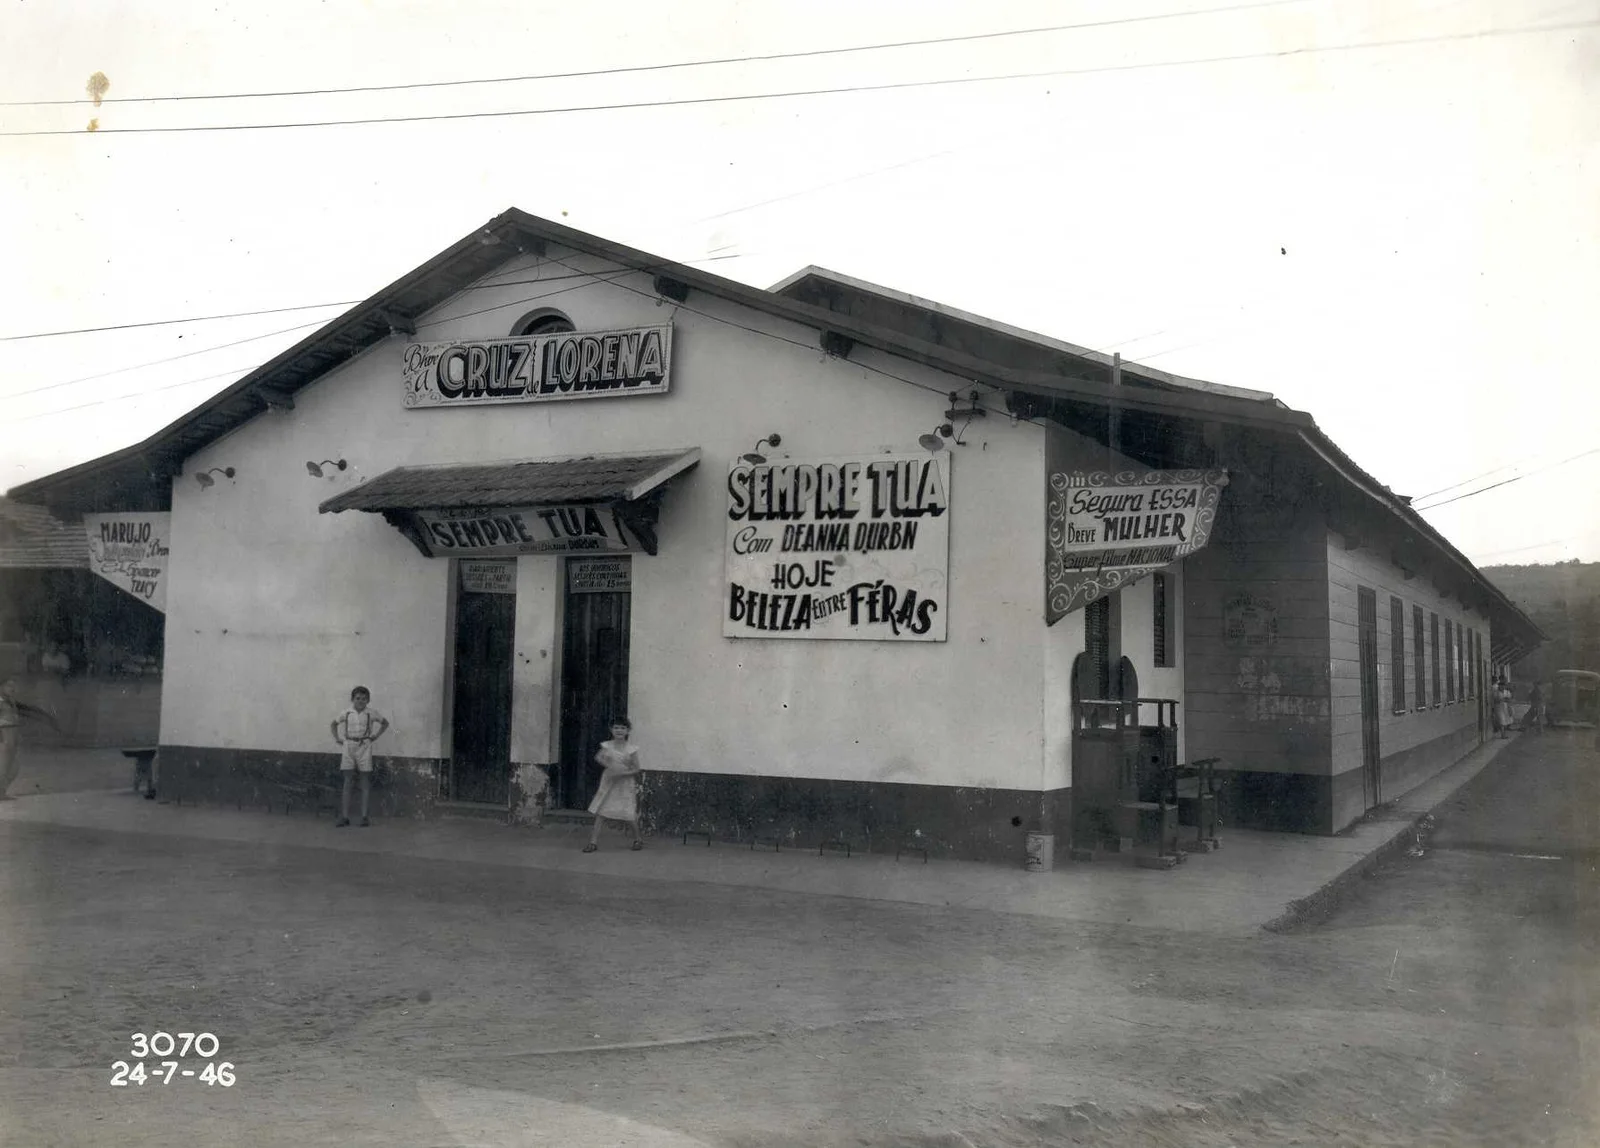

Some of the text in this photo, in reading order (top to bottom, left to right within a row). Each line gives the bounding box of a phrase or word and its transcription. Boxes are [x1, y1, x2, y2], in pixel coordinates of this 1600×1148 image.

[436, 341, 534, 398] CRUZ
[540, 329, 665, 391] LORENA
[728, 460, 947, 521] SEMPRE TUA
[1070, 488, 1197, 519] Segura ESSA
[101, 522, 151, 543] MARUJO
[432, 507, 608, 548] SEMPRE TUA
[733, 526, 774, 555] Com
[781, 524, 851, 552] DEANNA
[1104, 513, 1187, 542] MULHER
[1126, 545, 1176, 566] NACIONAL
[771, 560, 835, 590] HOJE
[729, 582, 812, 631] BELEZA
[847, 579, 938, 636] FÉRAS
